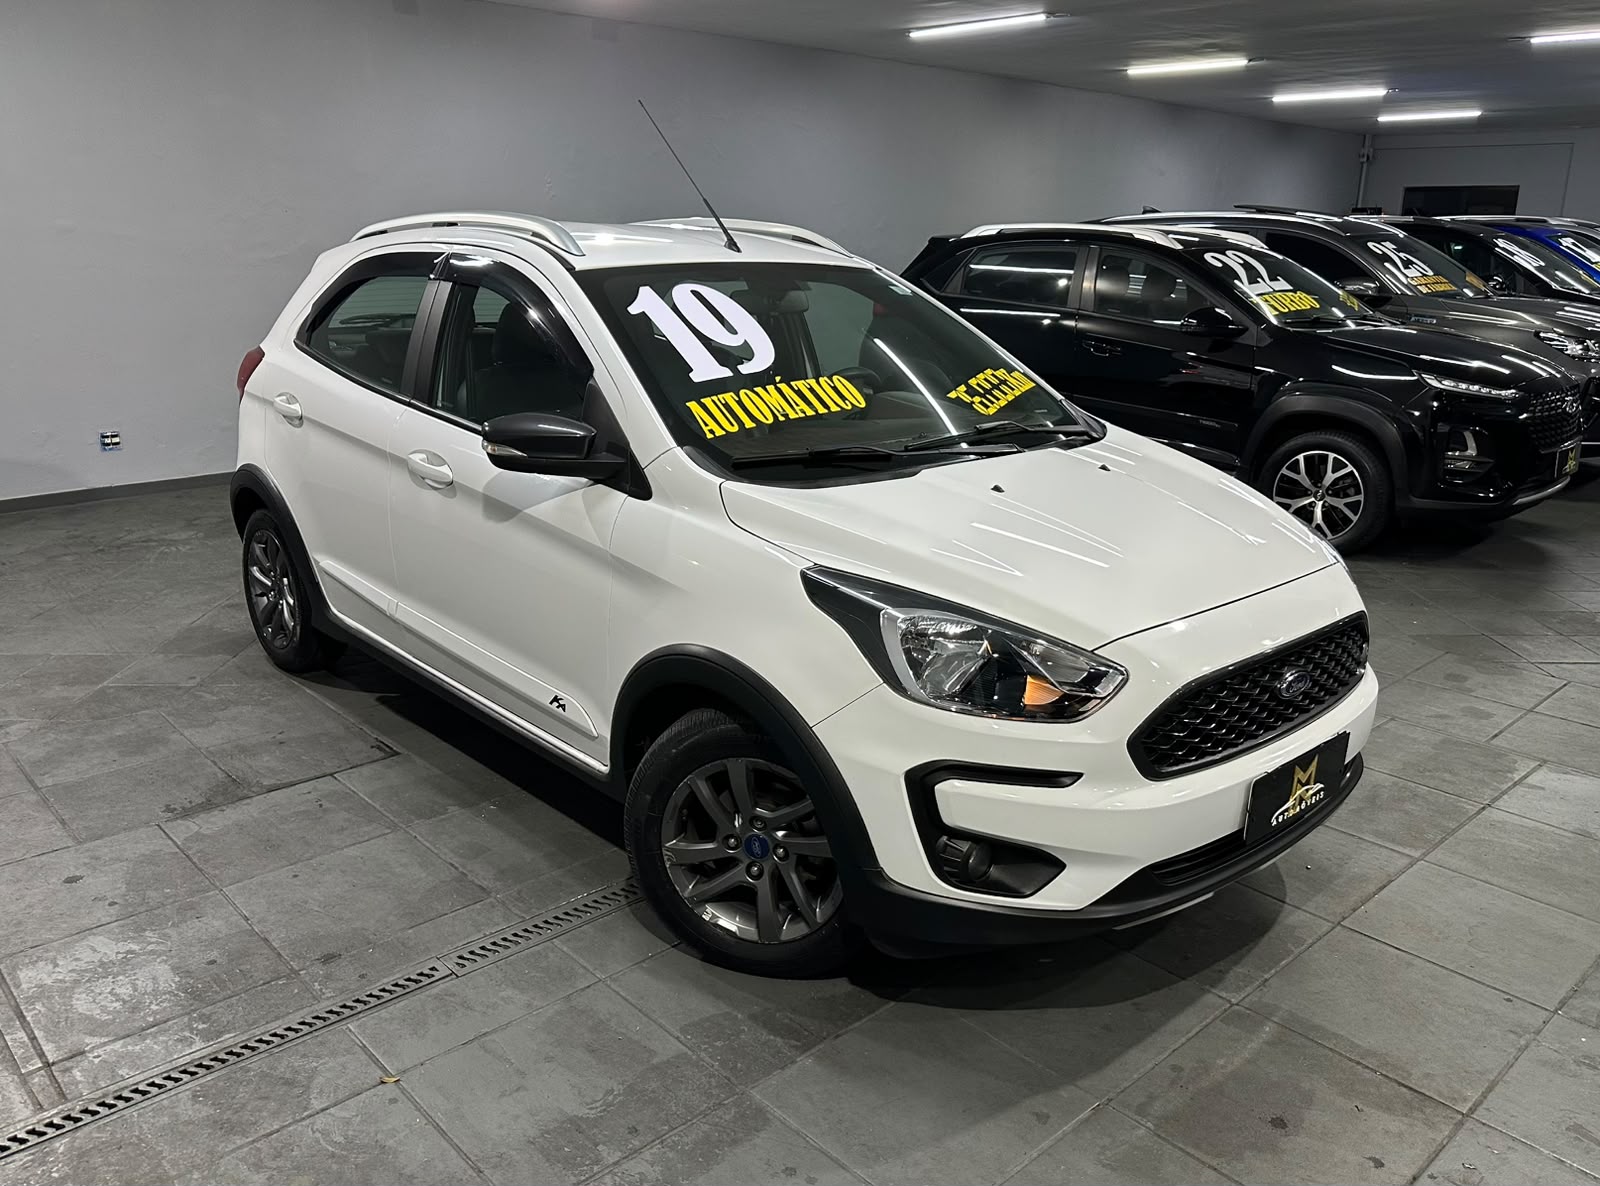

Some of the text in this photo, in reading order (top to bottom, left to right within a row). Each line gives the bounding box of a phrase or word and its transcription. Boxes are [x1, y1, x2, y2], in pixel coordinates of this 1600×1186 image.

[1203, 250, 1294, 296] 22
[1367, 241, 1434, 277] 25
[1492, 238, 1546, 267] 18
[1249, 291, 1320, 316] TURBO
[626, 283, 776, 383] 19
[686, 375, 867, 440] AUTOMÁTICO
